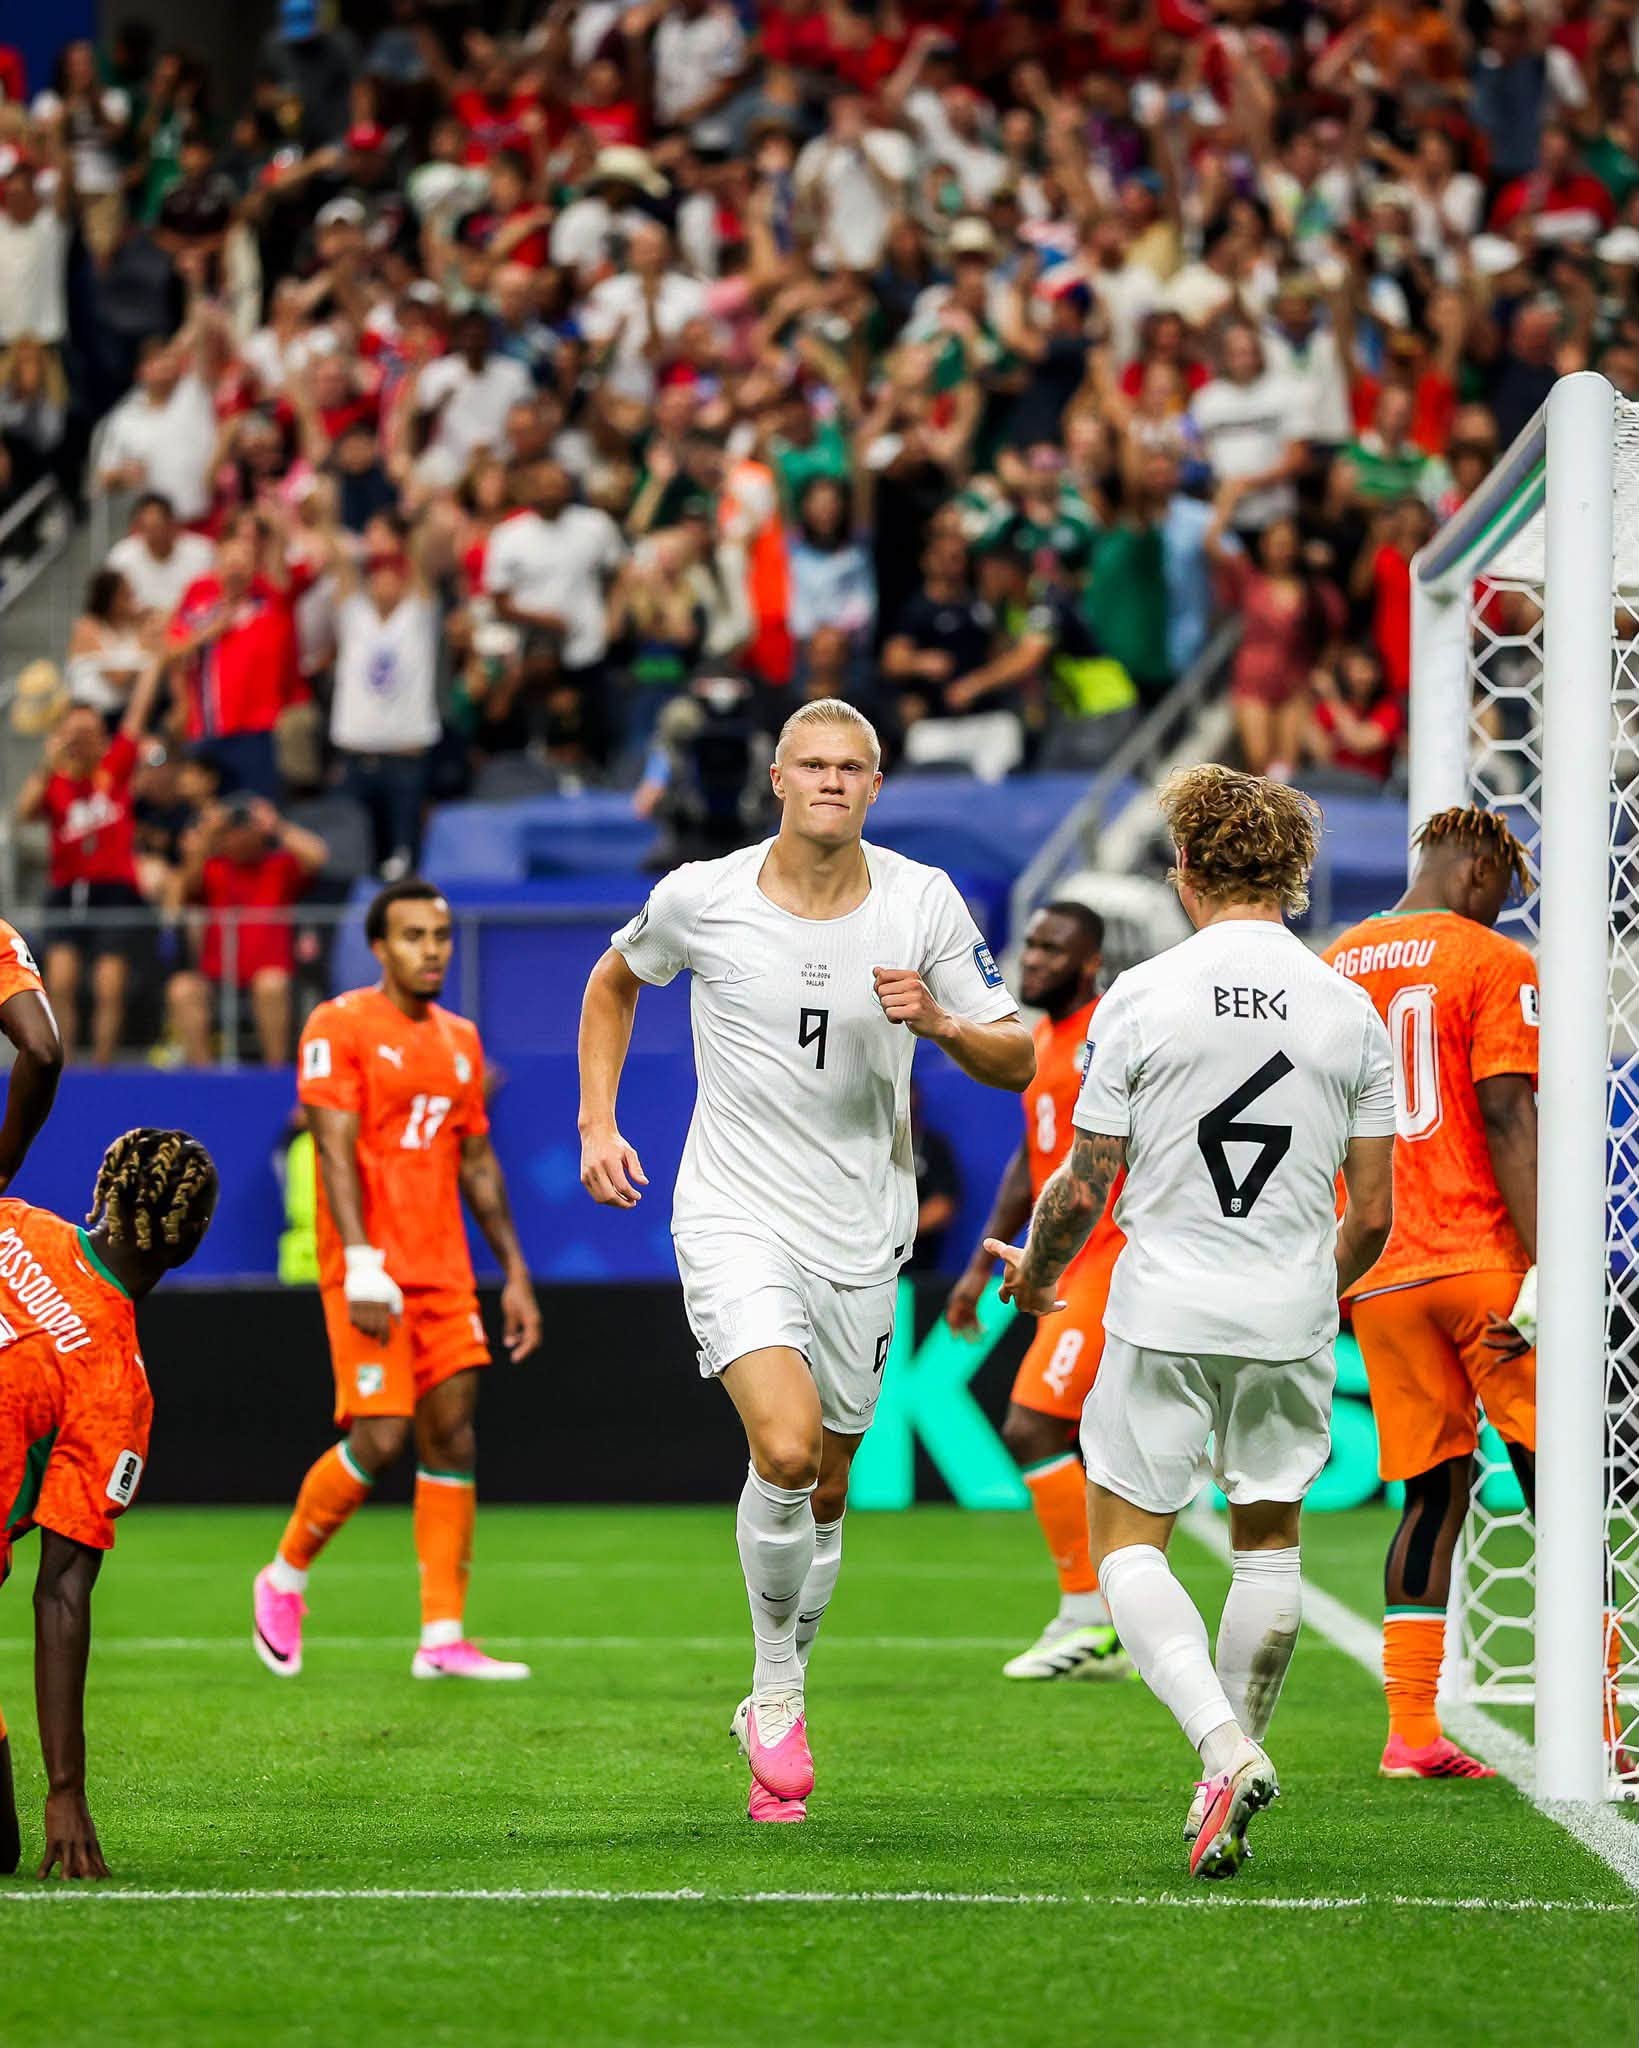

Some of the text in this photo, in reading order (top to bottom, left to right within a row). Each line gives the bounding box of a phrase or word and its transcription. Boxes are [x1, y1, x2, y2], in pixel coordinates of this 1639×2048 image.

[1334, 938, 1437, 977] AGBADOU
[1214, 986, 1288, 1021] BERG
[798, 1007, 829, 1070] 9
[400, 1093, 453, 1150] 17
[1036, 1093, 1056, 1153] 8
[1197, 1049, 1296, 1218] 6
[1049, 1328, 1086, 1376] 8
